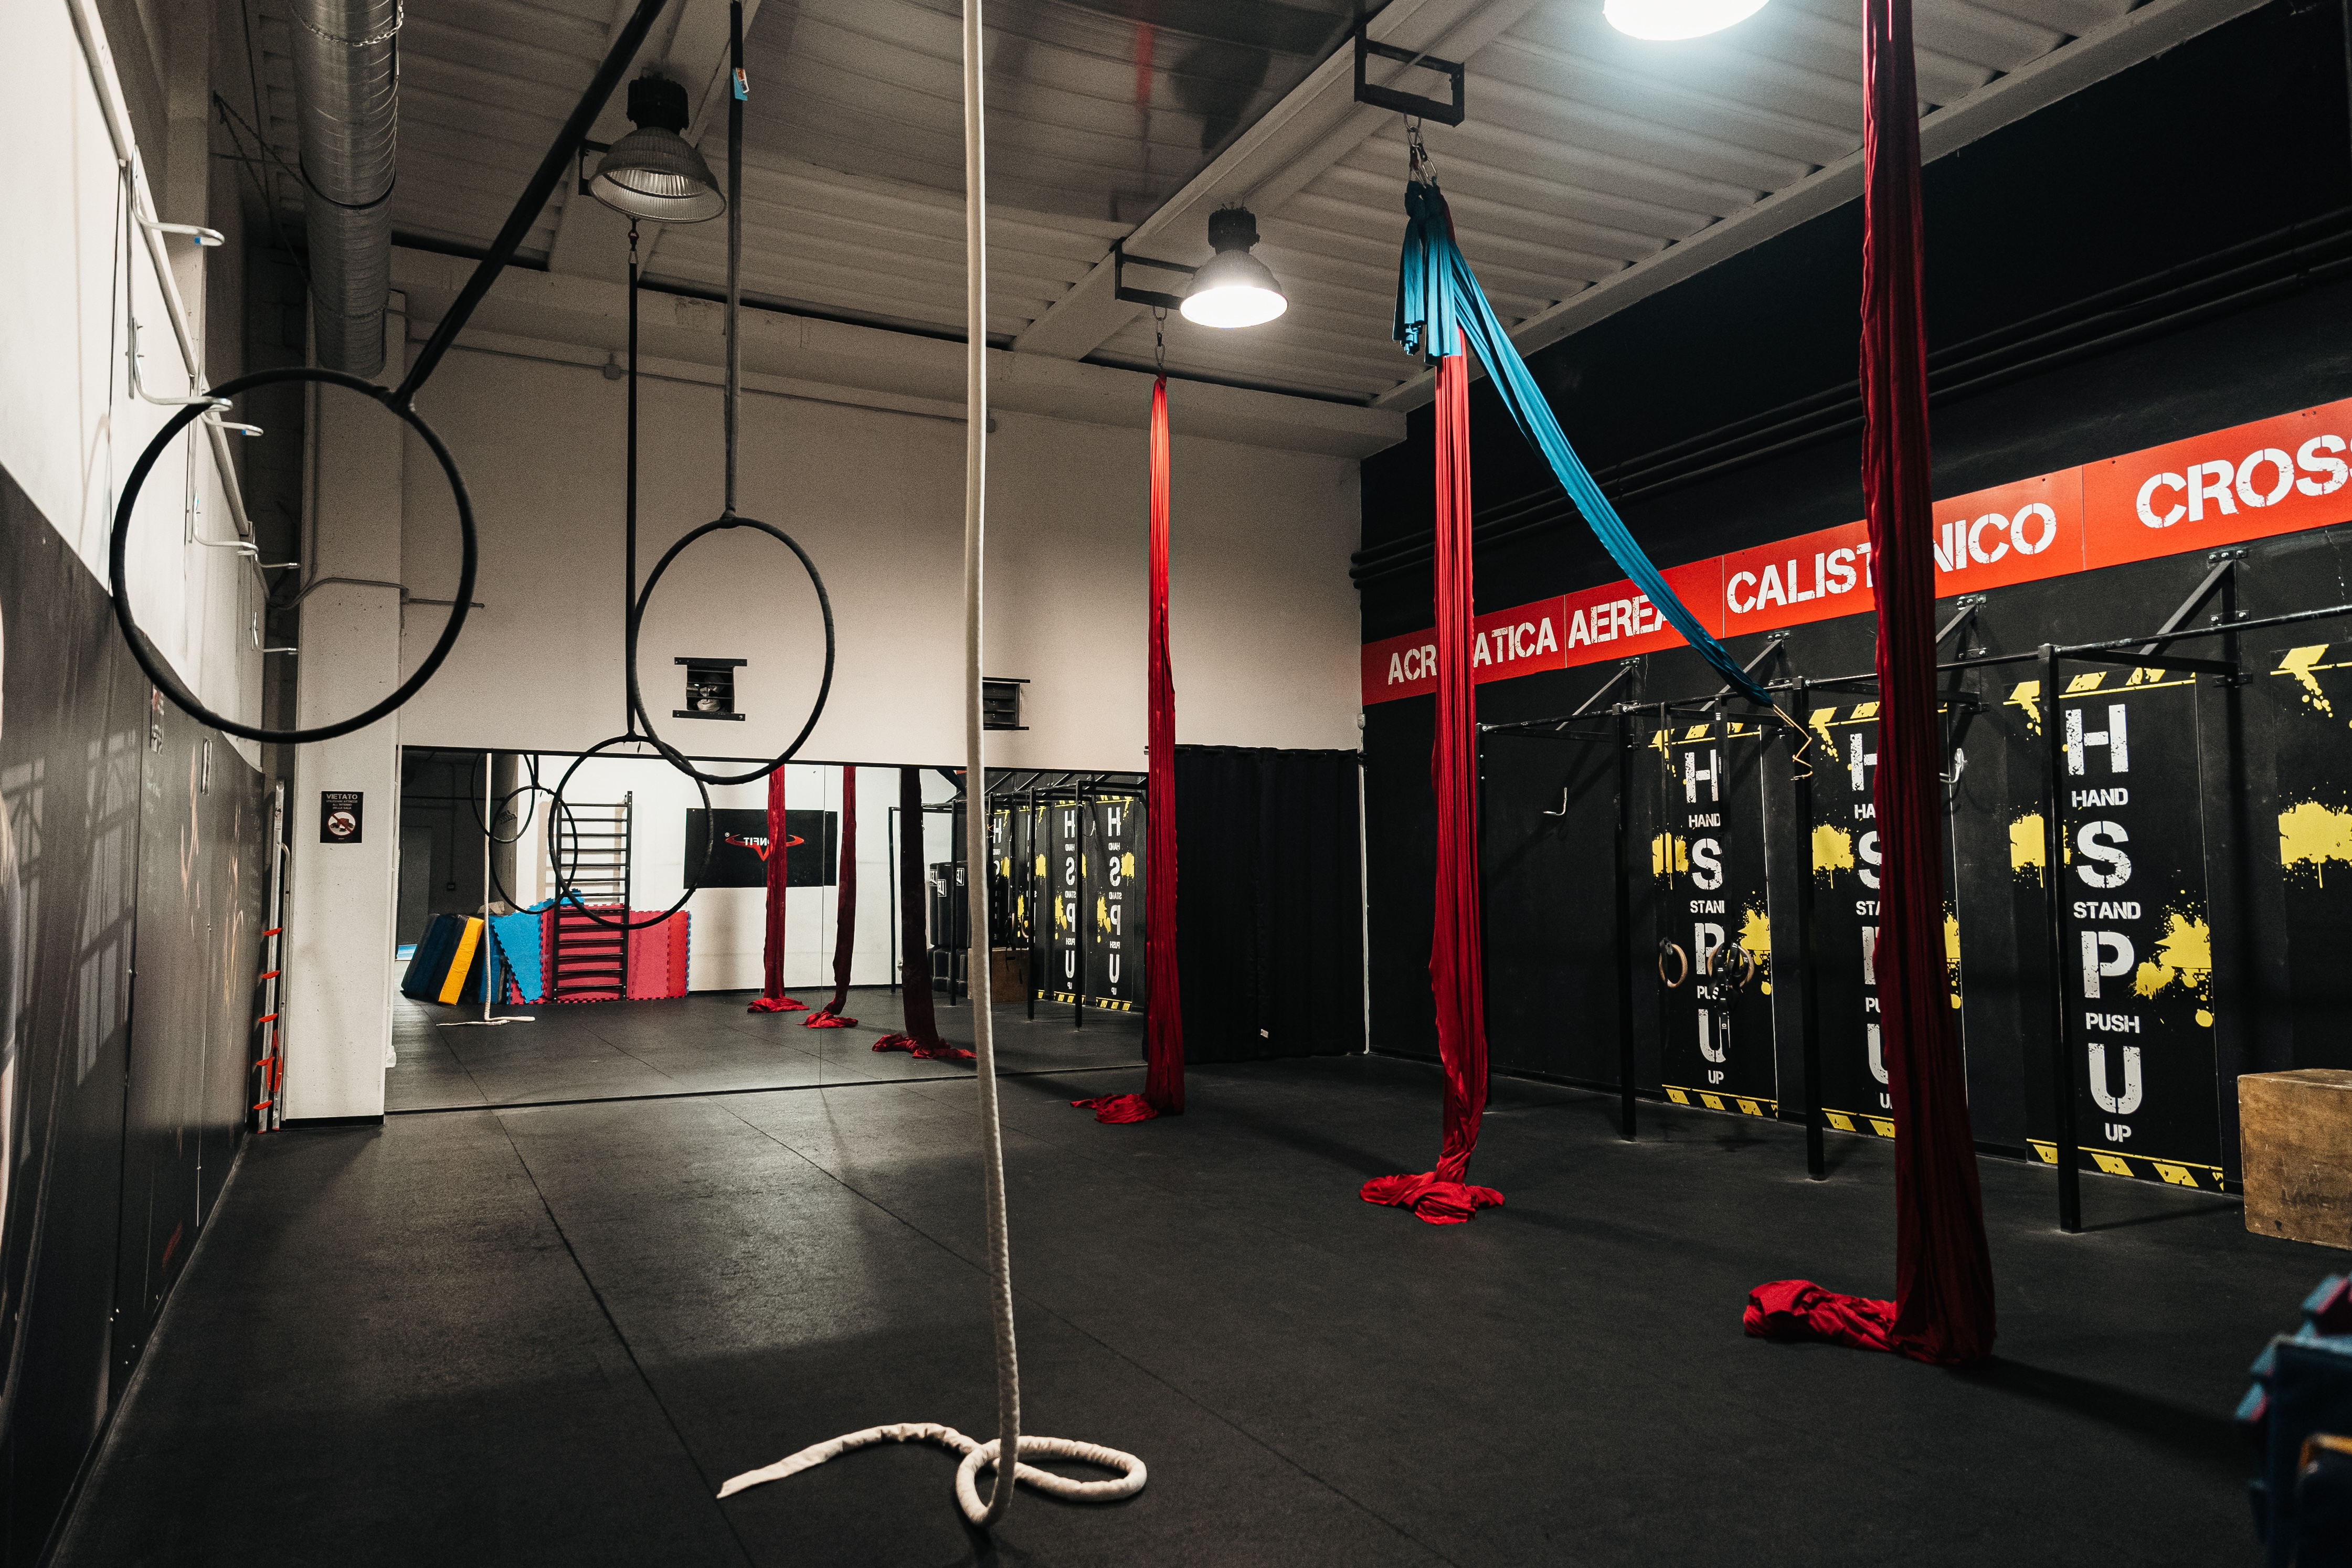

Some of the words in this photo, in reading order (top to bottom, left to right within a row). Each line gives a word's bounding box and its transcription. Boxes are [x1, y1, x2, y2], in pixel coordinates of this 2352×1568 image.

[2136, 435, 2352, 528] CROS
[1726, 502, 2056, 614] CALISTNICO
[1388, 617, 1558, 684] ACRATICA
[2065, 704, 2128, 776] H
[1684, 749, 1717, 803] H
[2072, 788, 2128, 807] HAND
[1688, 813, 1721, 828] HAND
[1854, 803, 1876, 819] HA
[1692, 838, 1723, 890] S
[2076, 821, 2132, 888] S
[2073, 901, 2141, 920] STAND
[2081, 931, 2134, 999] P
[2085, 1012, 2139, 1034] PUSH
[1708, 1070, 1724, 1085] UP
[2088, 1043, 2142, 1115] U
[2104, 1124, 2132, 1142] UP
